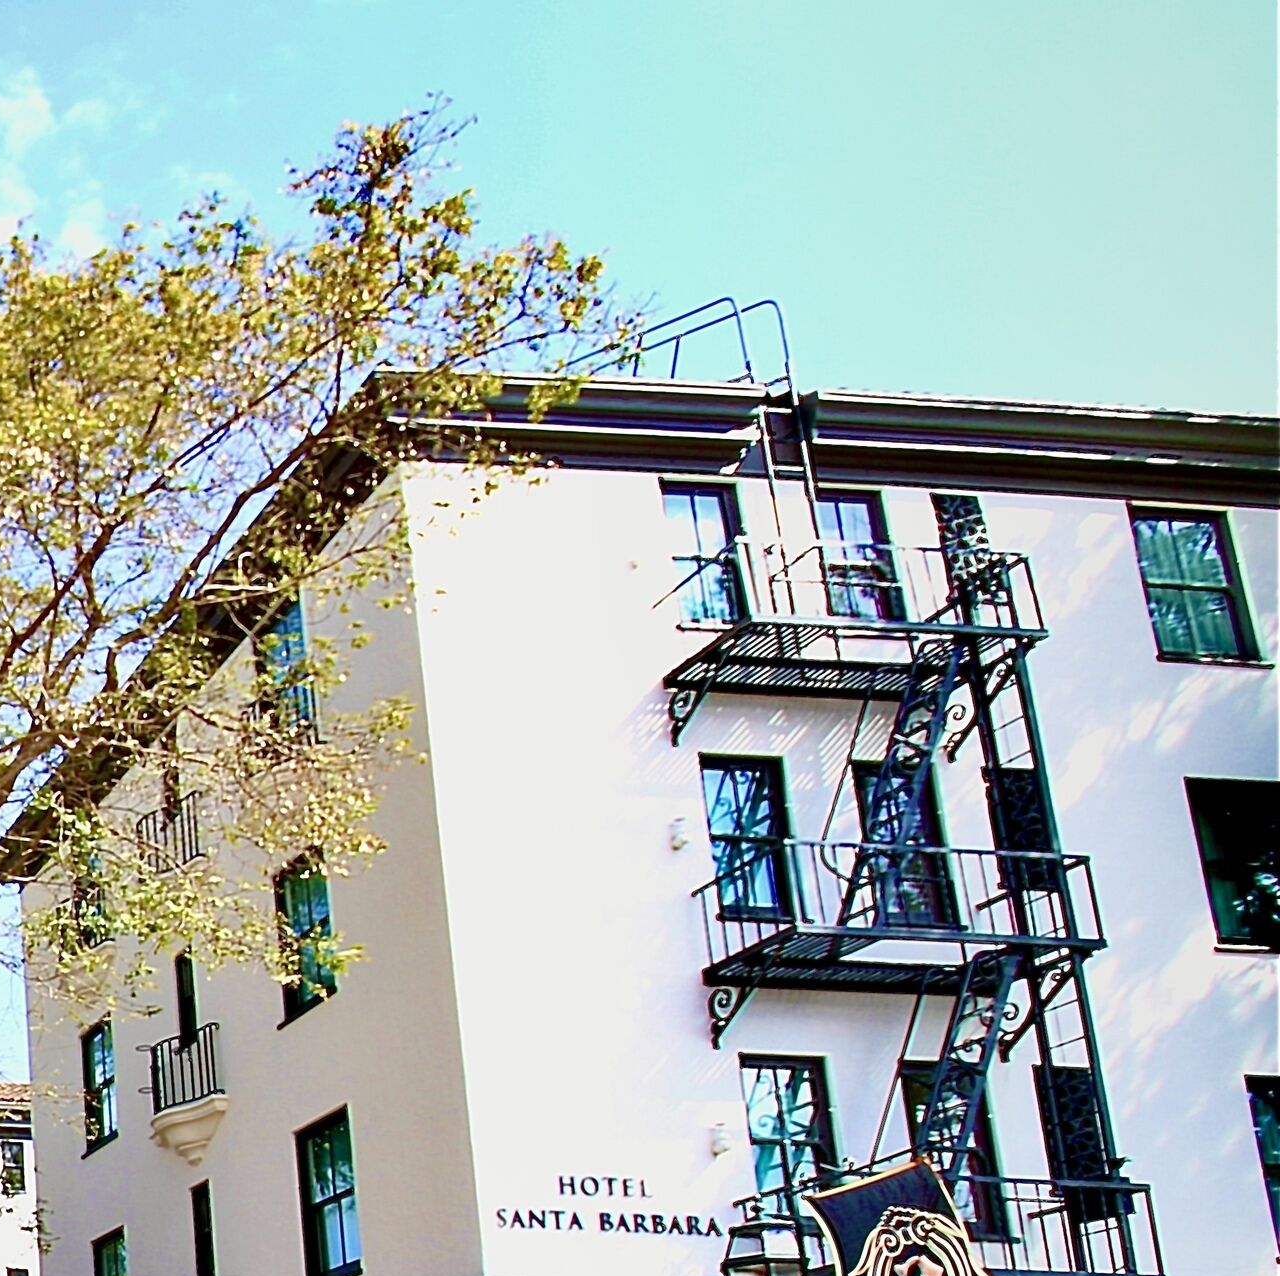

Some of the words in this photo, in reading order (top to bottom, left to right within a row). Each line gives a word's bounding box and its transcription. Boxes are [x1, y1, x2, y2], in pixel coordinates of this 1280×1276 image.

[558, 1175, 653, 1198] HOTEL
[496, 1208, 584, 1231] SANTA
[598, 1211, 724, 1238] BARBARA
